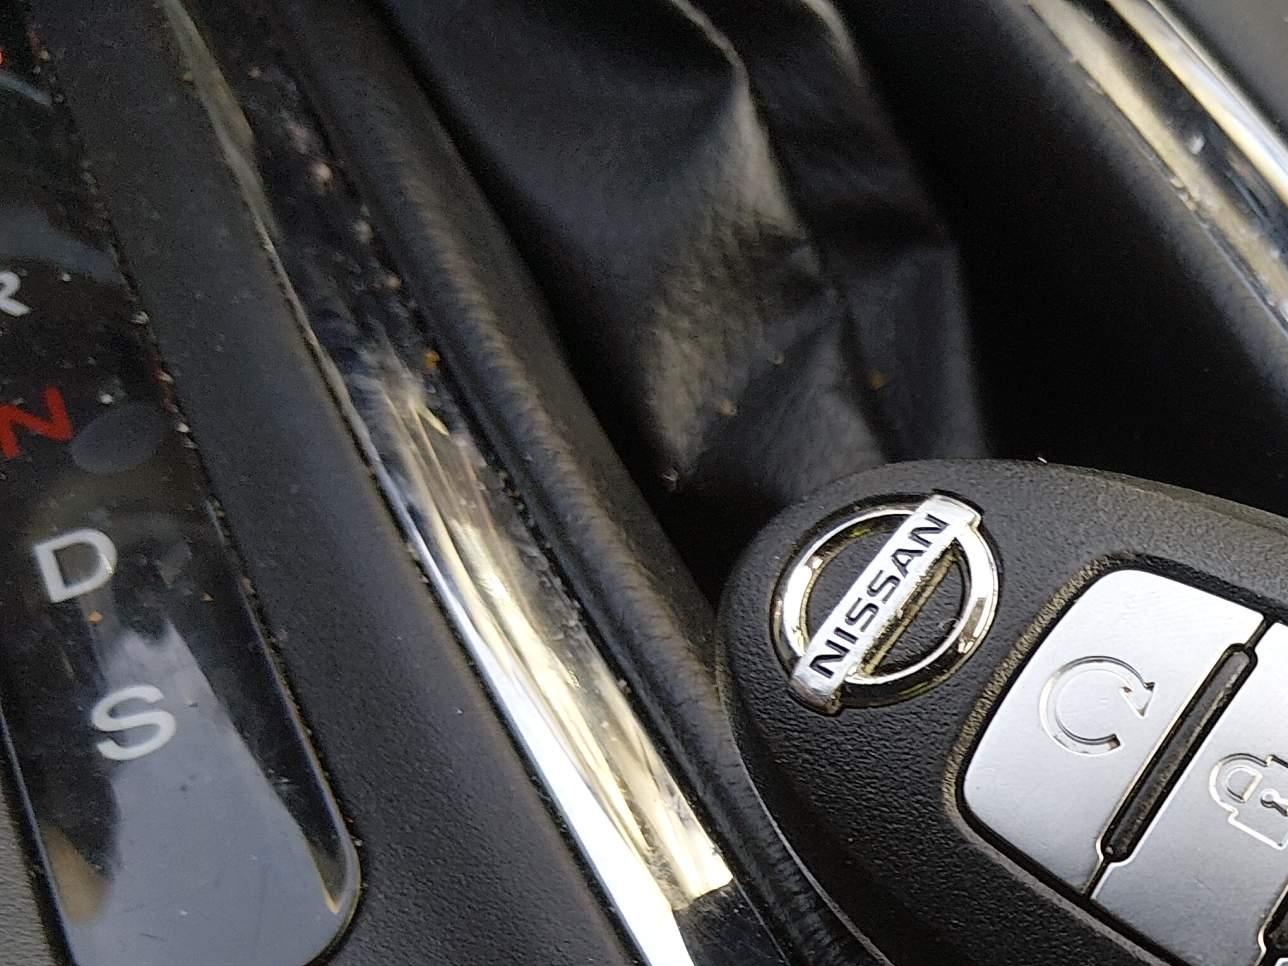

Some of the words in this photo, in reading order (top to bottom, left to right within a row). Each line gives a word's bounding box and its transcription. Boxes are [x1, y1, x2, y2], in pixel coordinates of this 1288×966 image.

[0, 385, 73, 458] N
[33, 528, 117, 603] D
[808, 513, 950, 679] NISSAN
[91, 685, 176, 760] S
